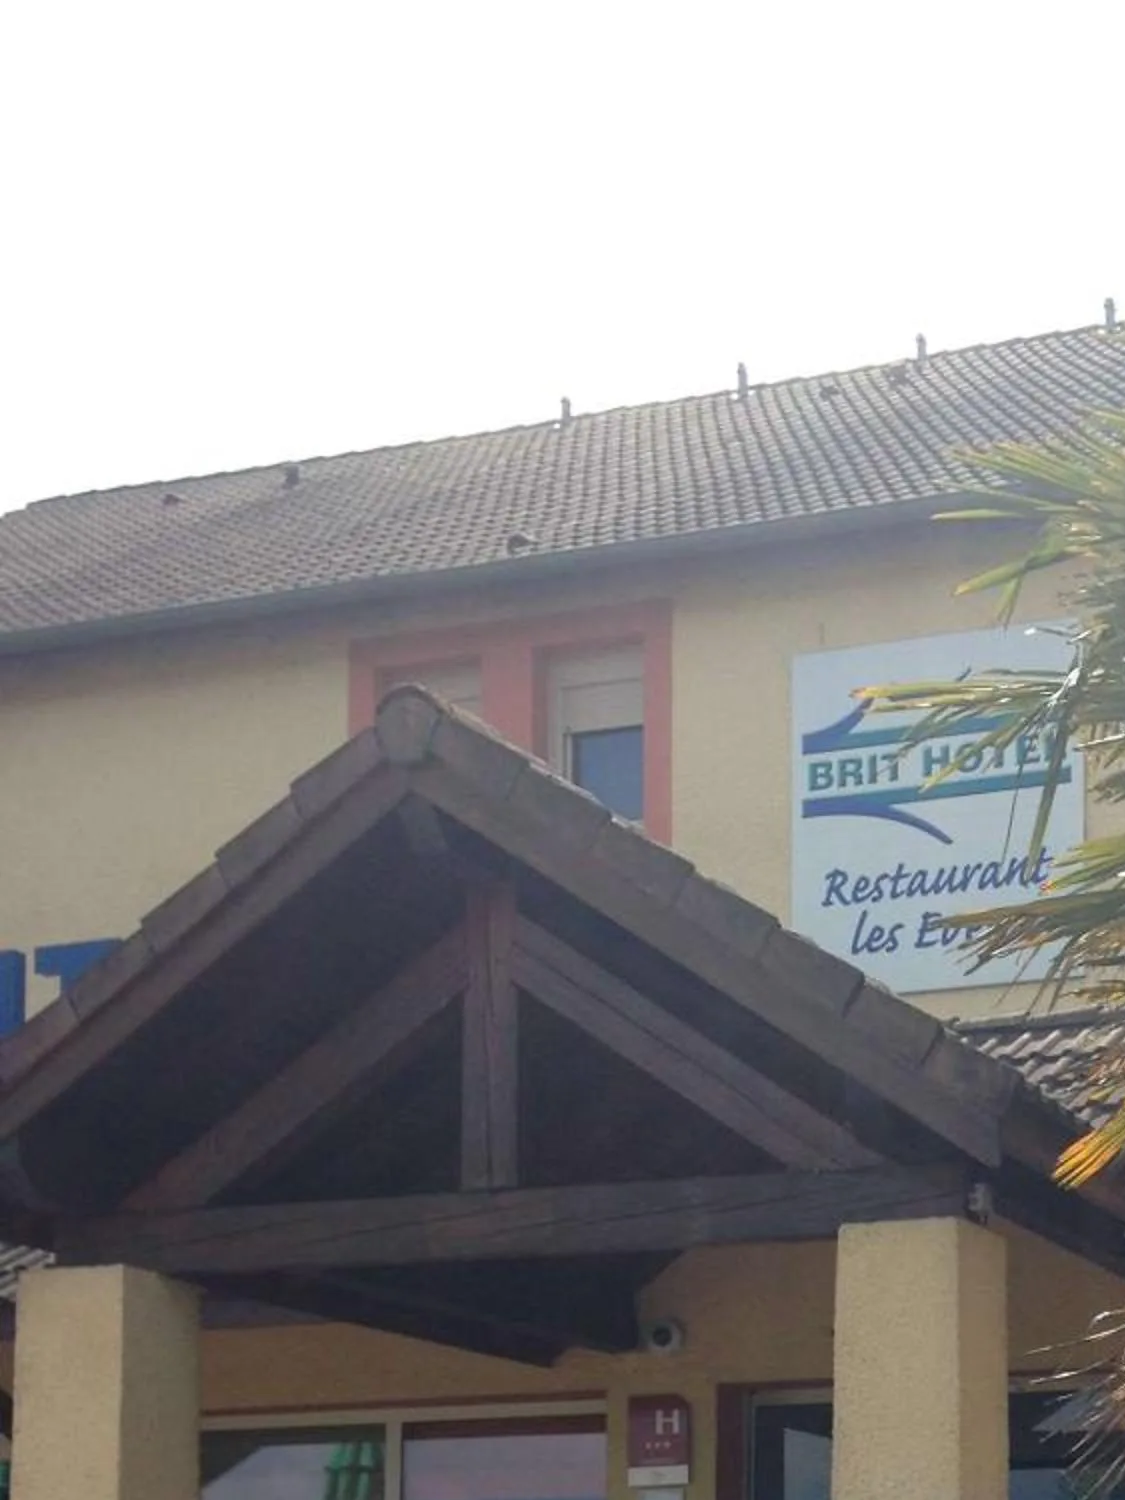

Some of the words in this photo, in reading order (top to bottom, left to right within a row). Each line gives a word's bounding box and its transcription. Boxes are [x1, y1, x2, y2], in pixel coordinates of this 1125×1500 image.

[807, 752, 901, 792] BRIT
[821, 847, 1055, 907] Restaurant
[851, 910, 905, 955] les
[655, 1408, 680, 1436] H
